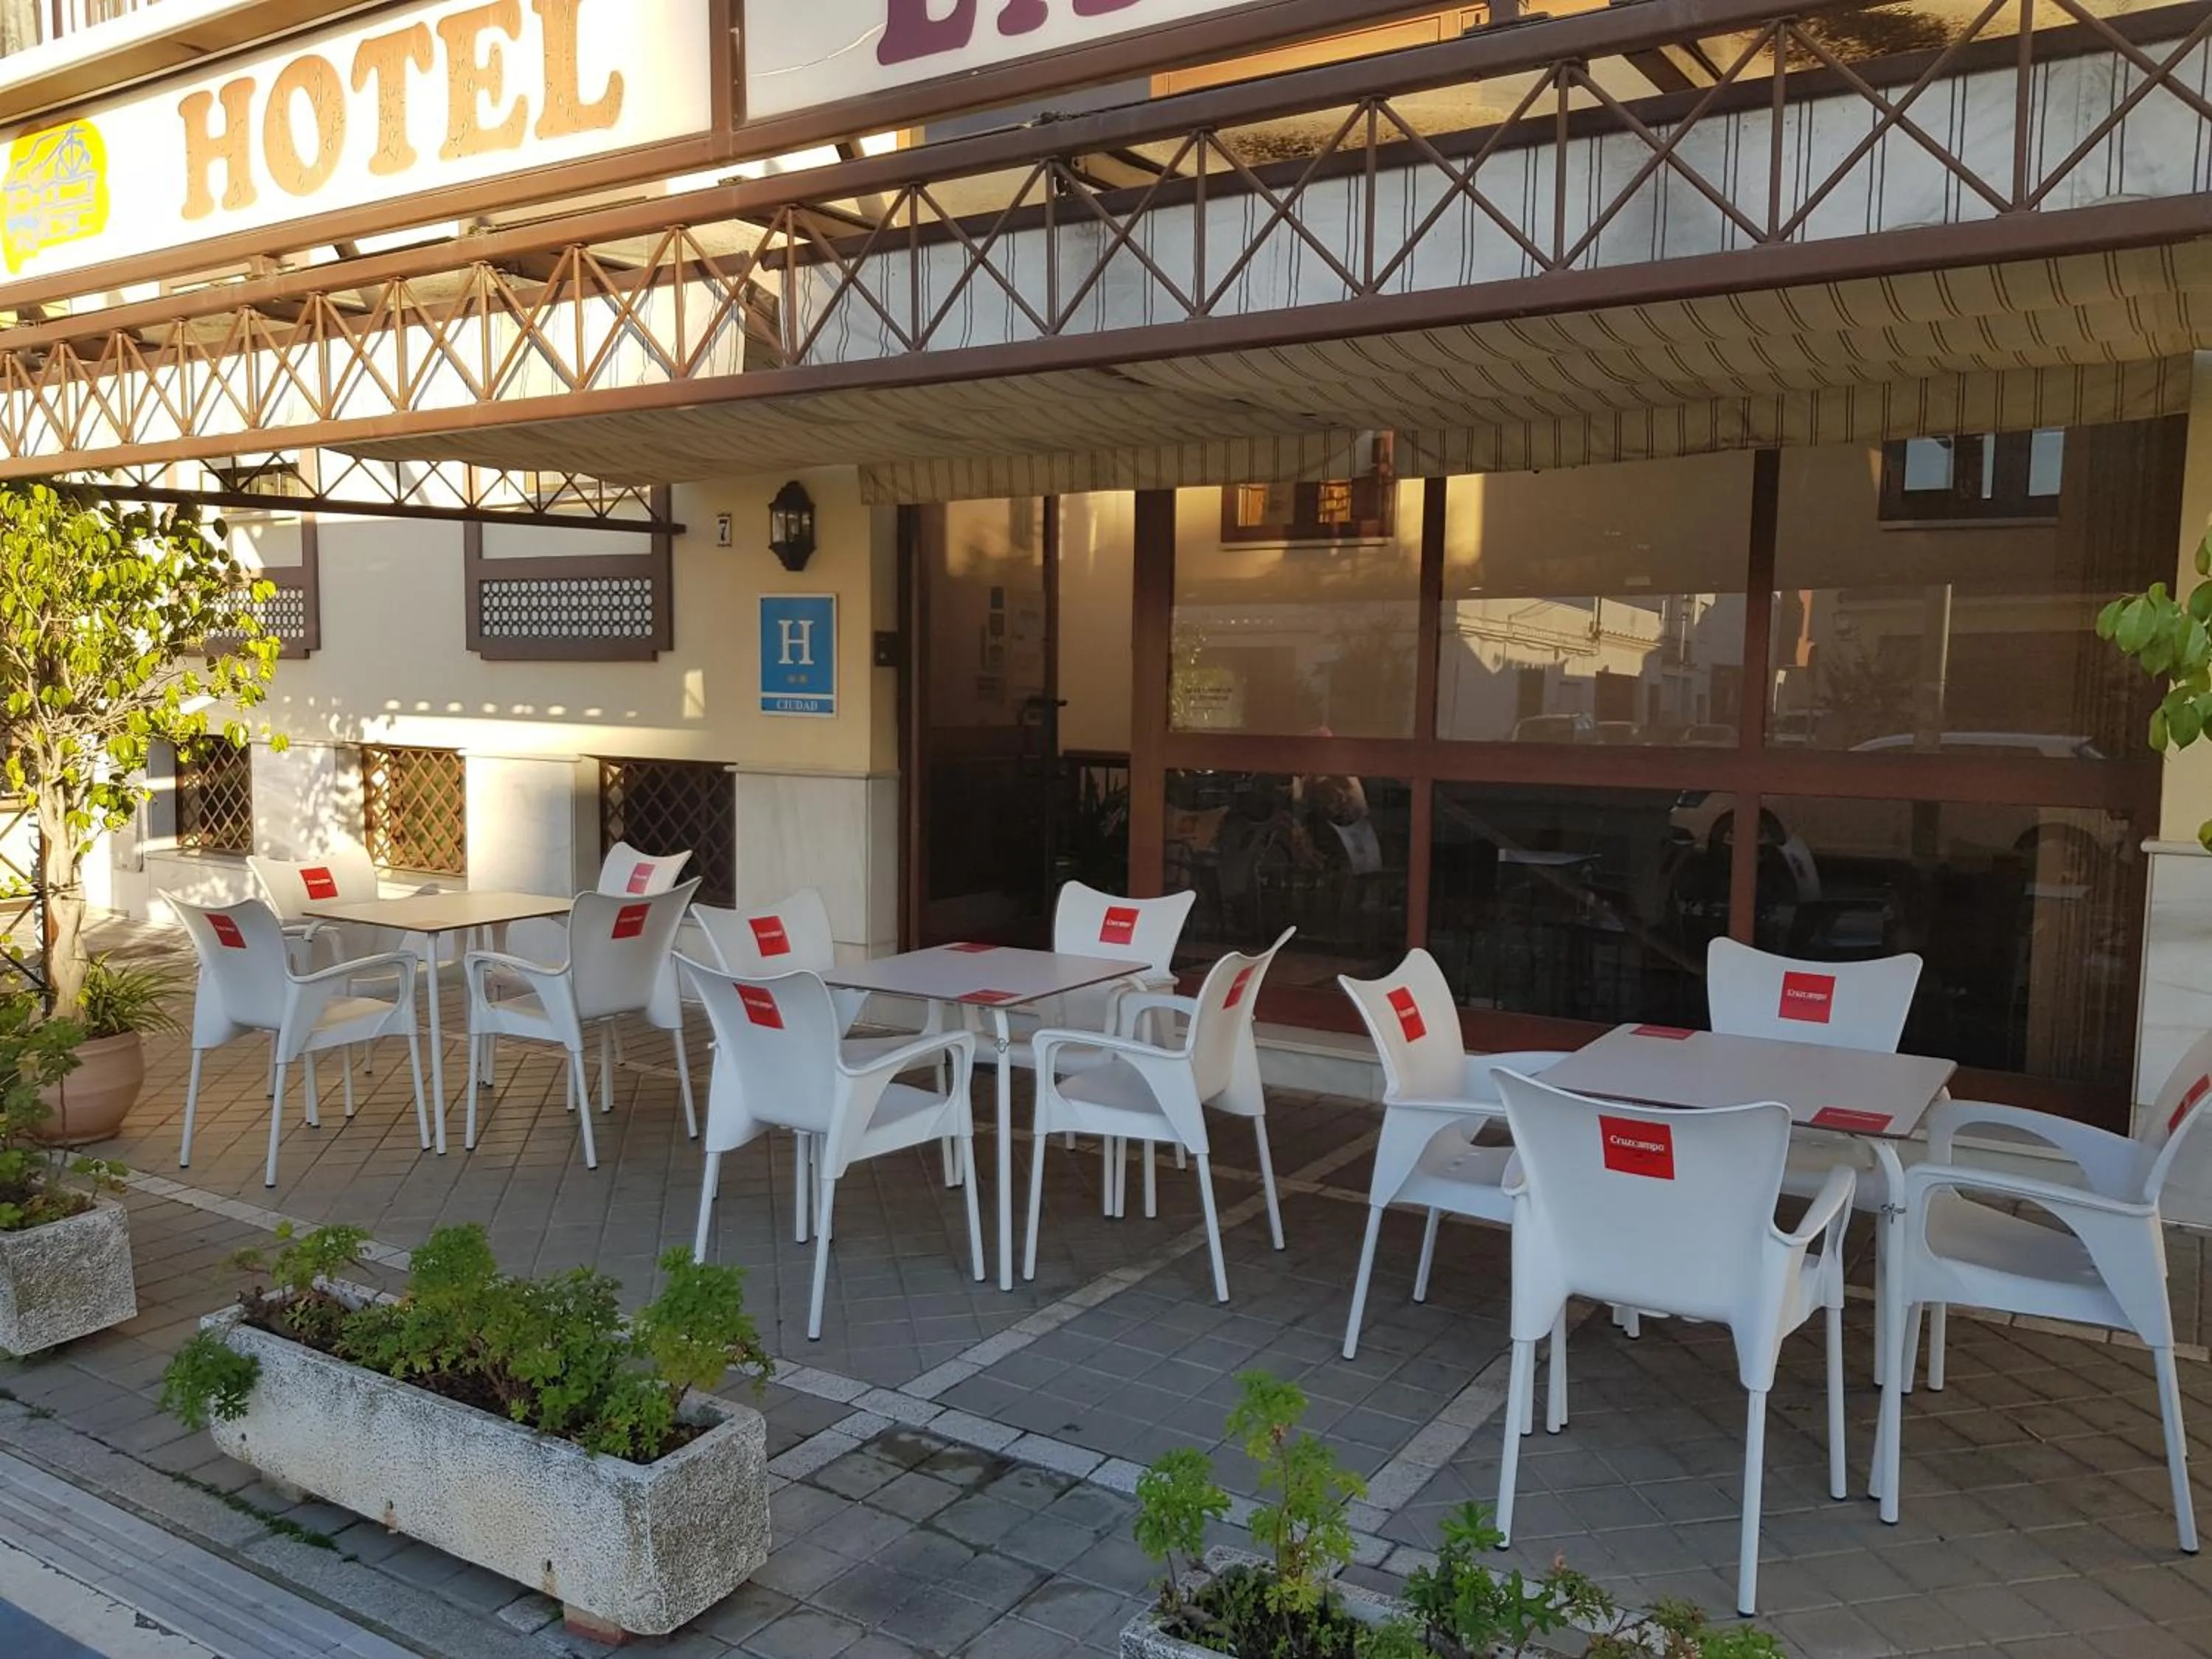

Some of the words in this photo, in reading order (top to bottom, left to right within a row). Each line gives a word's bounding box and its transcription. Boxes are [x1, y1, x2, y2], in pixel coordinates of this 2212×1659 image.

[178, 0, 625, 220] HOTEL
[719, 518, 728, 541] 7
[778, 619, 815, 665] H
[776, 699, 818, 711] CIUDAD
[1610, 1135, 1665, 1152] Cruzcampo
